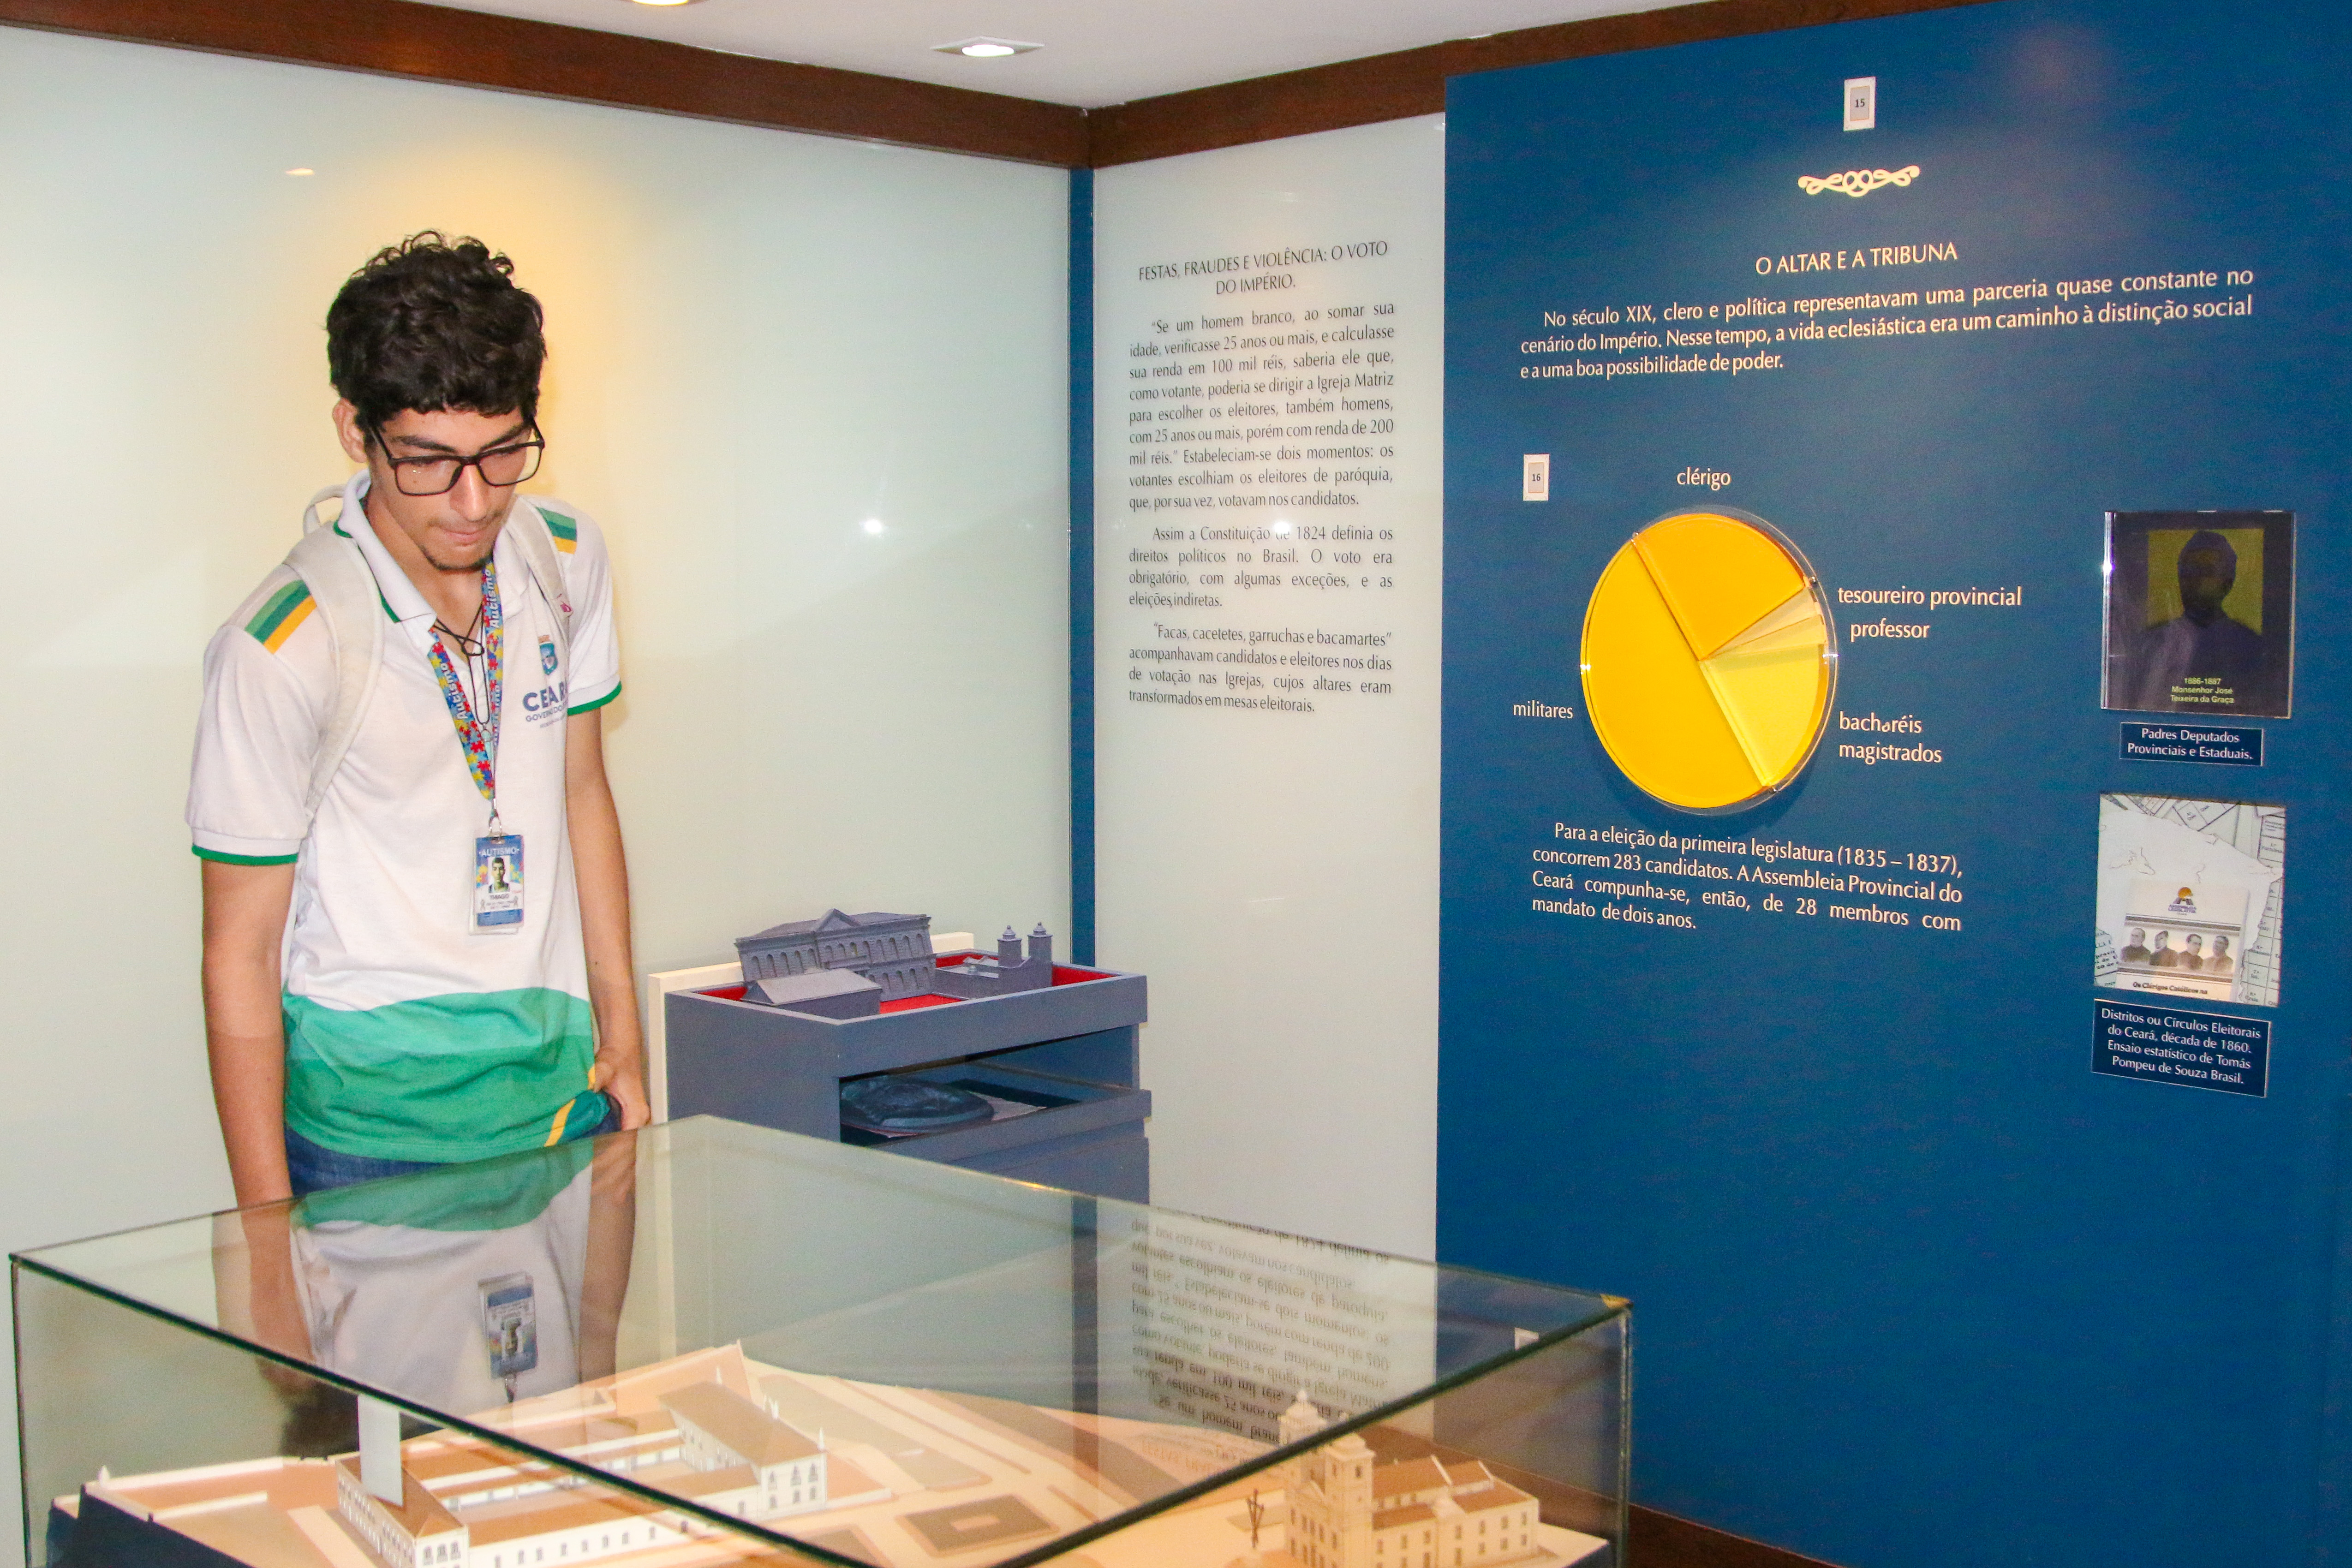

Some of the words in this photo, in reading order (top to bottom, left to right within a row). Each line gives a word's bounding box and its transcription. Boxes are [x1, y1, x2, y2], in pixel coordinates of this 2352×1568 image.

[1855, 98, 1865, 107] 15
[1139, 263, 1180, 281] FESTAS,
[1184, 256, 1240, 276] FRAUDES
[1243, 255, 1249, 270] E
[1253, 246, 1327, 268] VIOLÊNCIA:
[1331, 245, 1343, 261] O
[1346, 240, 1388, 259] VOTO
[1755, 256, 1772, 275] O
[1776, 252, 1831, 274] ALTAR
[1837, 250, 1846, 269] E
[1851, 250, 1866, 268] A
[1869, 242, 1958, 267] TRIBUNA
[1216, 279, 1237, 295] DO
[1240, 272, 1296, 292] IMPÉRIO.
[1544, 311, 1566, 327] No
[1572, 306, 1619, 326] século
[1626, 304, 1657, 324] XIX,
[1664, 302, 1703, 321] clero
[1709, 305, 1719, 318] e
[1725, 297, 1786, 323] política
[1794, 292, 1918, 318] representavam
[1926, 289, 1965, 305] uma
[1973, 278, 2048, 307] parceria
[2056, 279, 2113, 302] quase
[2121, 270, 2218, 292] constante
[2227, 270, 2254, 286] no
[1521, 335, 1575, 354] cenário
[1577, 333, 1597, 351] do
[1600, 331, 1662, 354] Império.
[1666, 329, 1713, 346] Nesse
[1715, 329, 1771, 348] tempo,
[1775, 328, 1785, 341] a
[1788, 320, 1824, 340] vida
[1828, 316, 1926, 339] eclesiástica
[1930, 318, 1958, 333] era
[1962, 316, 1991, 331] um
[1995, 305, 2078, 329] caminho
[2083, 304, 2094, 324] à
[2098, 299, 2188, 325] distinção
[2193, 294, 2252, 318] social
[1130, 341, 1161, 358] idade,
[1164, 339, 1221, 354] verificasse
[1223, 335, 1237, 351] 25
[1240, 337, 1267, 349] anos
[1269, 335, 1284, 347] ou
[1287, 329, 1318, 345] mais,
[1321, 332, 1329, 343] e
[1331, 324, 1395, 342] calculasse
[1520, 367, 1529, 379] e
[1531, 366, 1539, 378] a
[1542, 364, 1573, 378] uma
[1576, 358, 1604, 376] boa
[1606, 353, 1707, 381] possibilidade
[1709, 352, 1730, 371] de
[1732, 350, 1783, 376] poder.
[1129, 389, 1159, 401] como
[1161, 385, 1204, 398] votante,
[1208, 380, 1250, 400] poderia
[1254, 382, 1266, 393] se
[1268, 376, 1304, 396] dirigir
[1307, 379, 1313, 390] a
[1317, 374, 1350, 394] Igreja
[1354, 371, 1394, 387] Matriz
[1129, 433, 1152, 444] com
[1154, 429, 1168, 443] 25
[1170, 431, 1196, 442] anos
[1197, 430, 1212, 441] ou
[1214, 425, 1243, 441] mais,
[1246, 423, 1283, 443] porém
[1286, 425, 1312, 437] com
[1315, 419, 1349, 436] renda
[1351, 418, 1367, 435] de
[1370, 418, 1394, 434] 200
[1532, 473, 1541, 481] 16
[1677, 466, 1731, 491] clérigo
[1838, 585, 1925, 604] tesoureiro
[1930, 586, 2022, 610] provincial
[1851, 617, 1930, 643] professor
[441, 662, 468, 719] Autismo
[1128, 666, 1142, 681] de
[1149, 669, 1191, 686] votação
[1199, 674, 1217, 685] nas
[1225, 671, 1265, 690] Igrejas,
[1273, 674, 1304, 693] cujos
[1313, 674, 1352, 692] altares
[1360, 682, 1392, 694] eram
[1513, 699, 1574, 719] militares
[2142, 728, 2177, 740] Padres
[2180, 730, 2240, 744] Deputados
[1839, 741, 1942, 765] magistrados
[2127, 743, 2186, 756] Provinciais
[2189, 747, 2196, 757] e
[2199, 746, 2253, 760] Estaduais.
[1555, 822, 1586, 841] Para
[1589, 829, 1598, 841] a
[1601, 826, 1655, 849] eleição
[1659, 830, 1677, 848] da
[1681, 834, 1747, 855] primeira
[1751, 837, 1834, 863] legislatura
[1837, 846, 1886, 867] (1835
[1907, 853, 1962, 879] 1837),
[1533, 849, 1610, 868] concorrem
[1613, 853, 1642, 871] 283
[1645, 857, 1733, 880] candidatos.
[1737, 864, 1750, 882] A
[1751, 866, 1845, 891] Assembleia
[1848, 875, 1935, 900] Provincial
[1939, 882, 1963, 903] do
[1532, 870, 1574, 889] Ceará
[1584, 880, 1690, 905] compunha-se,
[1702, 890, 1750, 912] então,
[1763, 893, 1783, 912] de
[1796, 897, 1817, 916] 28
[1830, 903, 1909, 926] membros
[1922, 915, 1961, 931] com
[1532, 898, 1596, 917] mandato
[1602, 902, 1620, 920] de
[1623, 904, 1654, 924] dois
[1656, 913, 1696, 929] anos.
[2101, 1008, 2144, 1023] Distritos
[2147, 1017, 2161, 1025] ou
[2164, 1016, 2209, 1031] Círculos
[2211, 1022, 2261, 1039] Eleitorais
[2107, 1024, 2122, 1036] do
[2124, 1026, 2158, 1041] Ceará,
[2161, 1031, 2200, 1046] década
[2203, 1037, 2217, 1049] de
[2221, 1039, 2251, 1053] 1860.
[2107, 1039, 2142, 1054] Ensaio
[2144, 1047, 2197, 1061] estatístico
[2199, 1052, 2213, 1064] de
[2216, 1054, 2251, 1069] Tomás
[2112, 1055, 2155, 1072] Pompeu
[2158, 1062, 2172, 1073] de
[2174, 1064, 2207, 1079] Souza
[2211, 1069, 2244, 1084] Brasil.
